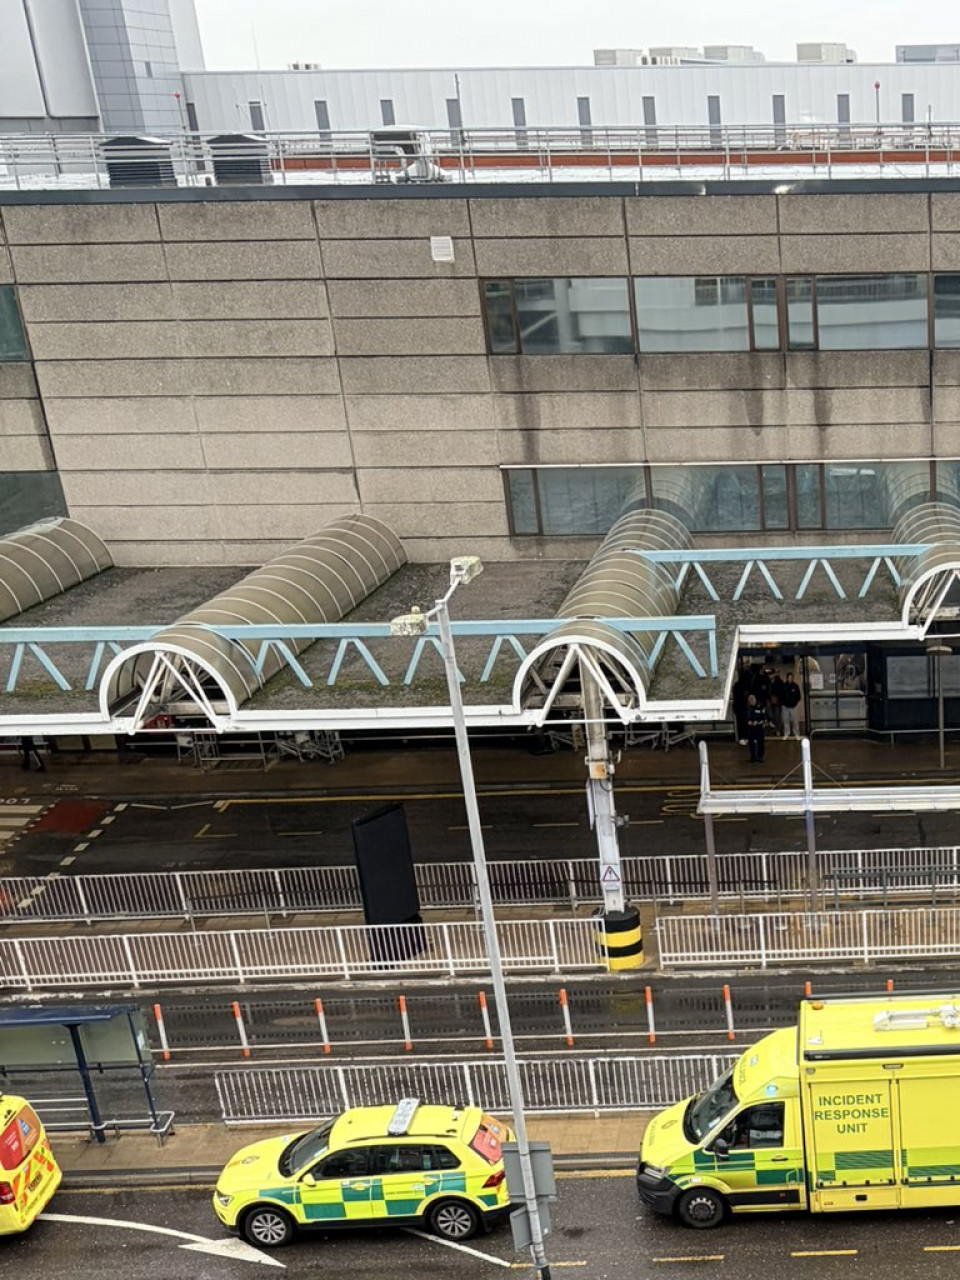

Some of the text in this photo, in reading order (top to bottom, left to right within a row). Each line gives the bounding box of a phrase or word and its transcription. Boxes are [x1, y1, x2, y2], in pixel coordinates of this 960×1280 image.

[818, 1093, 883, 1106] INCIDENT
[814, 1107, 889, 1121] RESPONSE
[836, 1122, 868, 1134] UNIT
